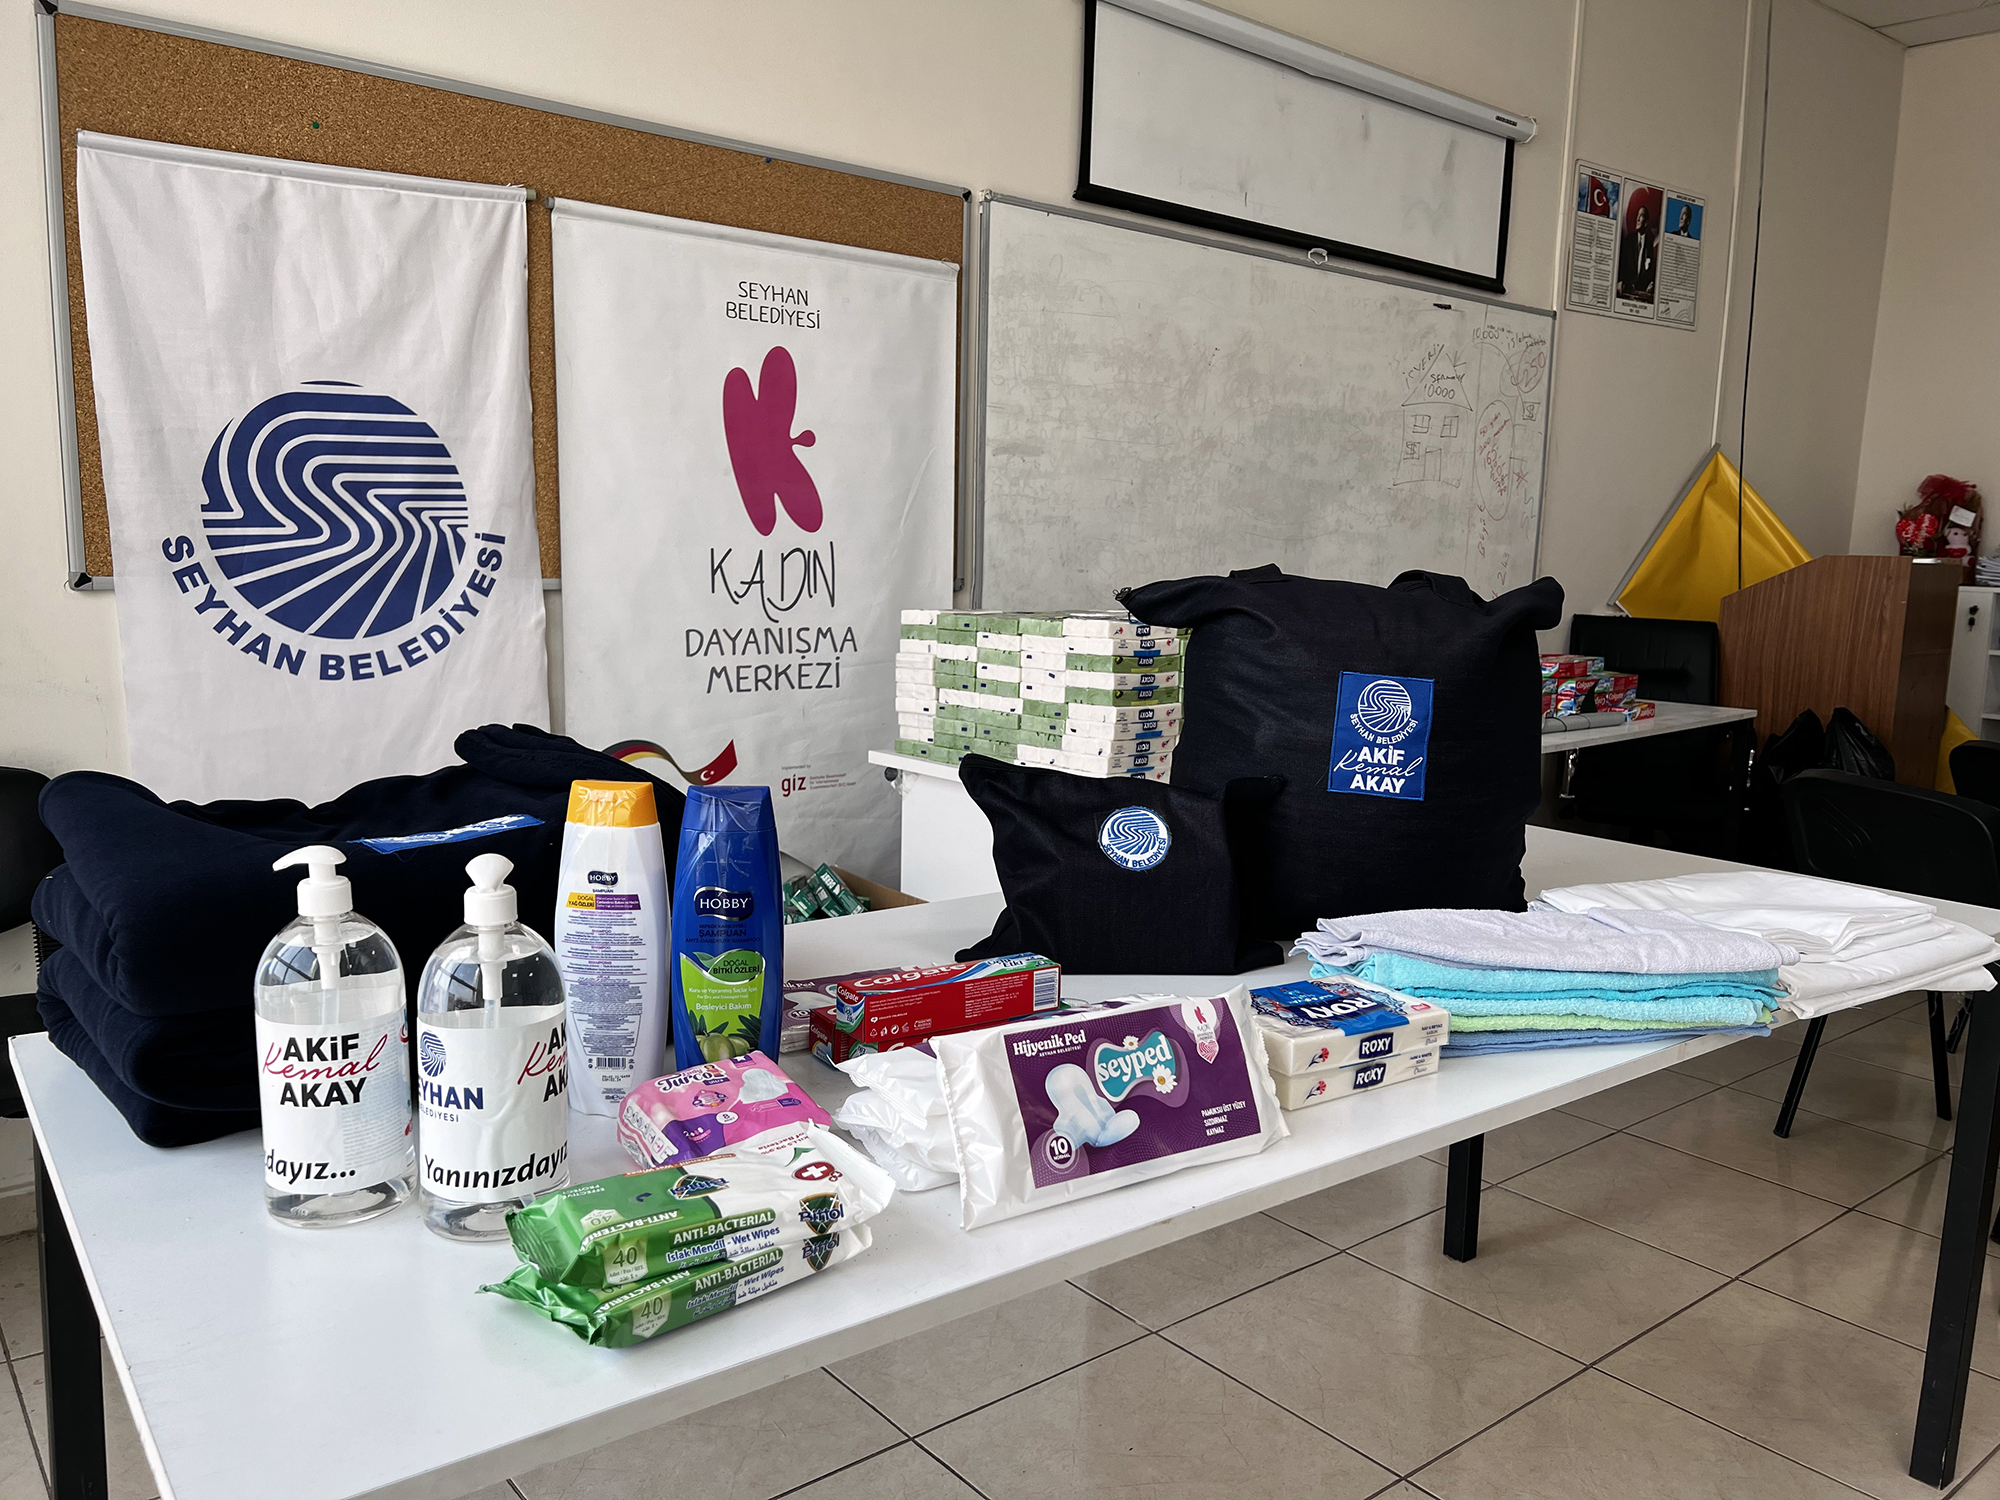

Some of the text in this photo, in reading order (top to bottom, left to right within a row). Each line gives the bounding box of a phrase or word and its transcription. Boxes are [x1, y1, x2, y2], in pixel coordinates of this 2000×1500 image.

[738, 280, 809, 307] SEYHAN
[725, 301, 821, 330] BELEDİYESİ
[710, 540, 836, 624] KADIN
[162, 531, 507, 681] SEYHAN BELEDİYESİ
[685, 626, 858, 660] DAYANIŞMA
[706, 656, 841, 694] MERKEZİ
[1350, 713, 1419, 745] SEYHAN BELEDİYESİ
[1333, 749, 1423, 777] Kemal
[1357, 745, 1405, 766] AKİF
[781, 773, 807, 797] giz
[1350, 773, 1406, 794] AKAY
[1103, 843, 1130, 866] SEYHAN
[700, 898, 748, 909] HOBBY
[698, 929, 747, 938] ŞAMPUAN
[713, 965, 760, 975] BİTKİ ÖZLERİ
[723, 959, 749, 967] DOĞAL
[853, 964, 967, 988] Colgate
[837, 986, 860, 1003] Colgate
[696, 1003, 728, 1011] Besleyici
[792, 1010, 809, 1018] 10
[1301, 998, 1378, 1019] ROXY
[810, 1024, 828, 1042] Colgate
[1012, 1029, 1087, 1057] Hijyenik Ped
[263, 1034, 388, 1080] Kemal
[1361, 1037, 1392, 1055] ROXY
[1097, 1034, 1173, 1083] seyped
[657, 1072, 713, 1091] Turco
[1356, 1067, 1384, 1085] ROXY
[280, 1077, 367, 1107] AKAY
[1050, 1138, 1068, 1156] 10
[590, 1215, 612, 1226] 40
[798, 1203, 845, 1223] Bittol
[673, 1211, 774, 1245] ANTI-BACTERIAL
[667, 1249, 691, 1263] Islak
[692, 1238, 726, 1255] Mendil
[732, 1235, 751, 1246] Wet
[751, 1226, 780, 1240] Wipes
[801, 1234, 840, 1260] Bittol
[613, 1246, 638, 1268] 40
[695, 1250, 782, 1292] ANTI-BACTERIAL
[687, 1296, 708, 1308] Islak
[708, 1282, 739, 1300] Mendil
[744, 1276, 760, 1286] Wet
[760, 1266, 785, 1280] Wipes
[640, 1296, 664, 1319] 40
